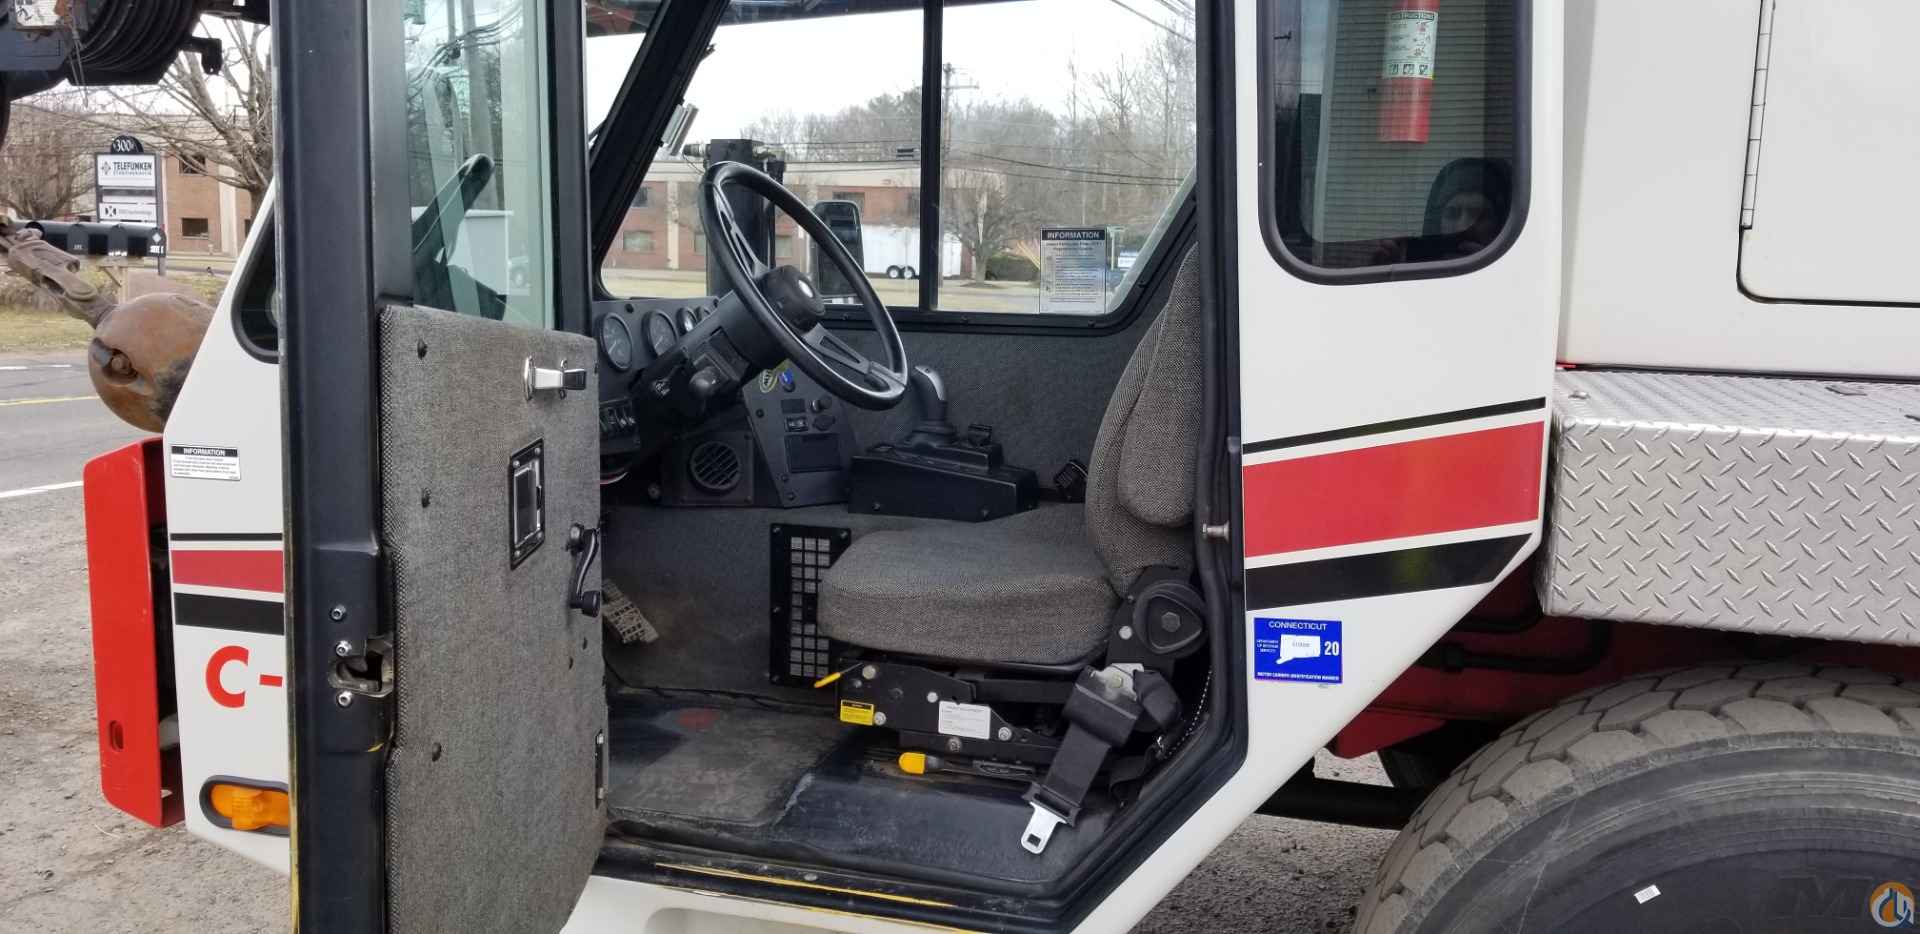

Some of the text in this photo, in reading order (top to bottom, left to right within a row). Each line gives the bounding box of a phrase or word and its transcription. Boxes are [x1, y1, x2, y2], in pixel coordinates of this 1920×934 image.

[113, 161, 152, 171] TELEFUNKEN
[1047, 231, 1100, 239] INFORMATION
[183, 447, 226, 456] INFORMATION
[1268, 621, 1328, 631] CONNECTICUT
[1324, 641, 1340, 656] 20
